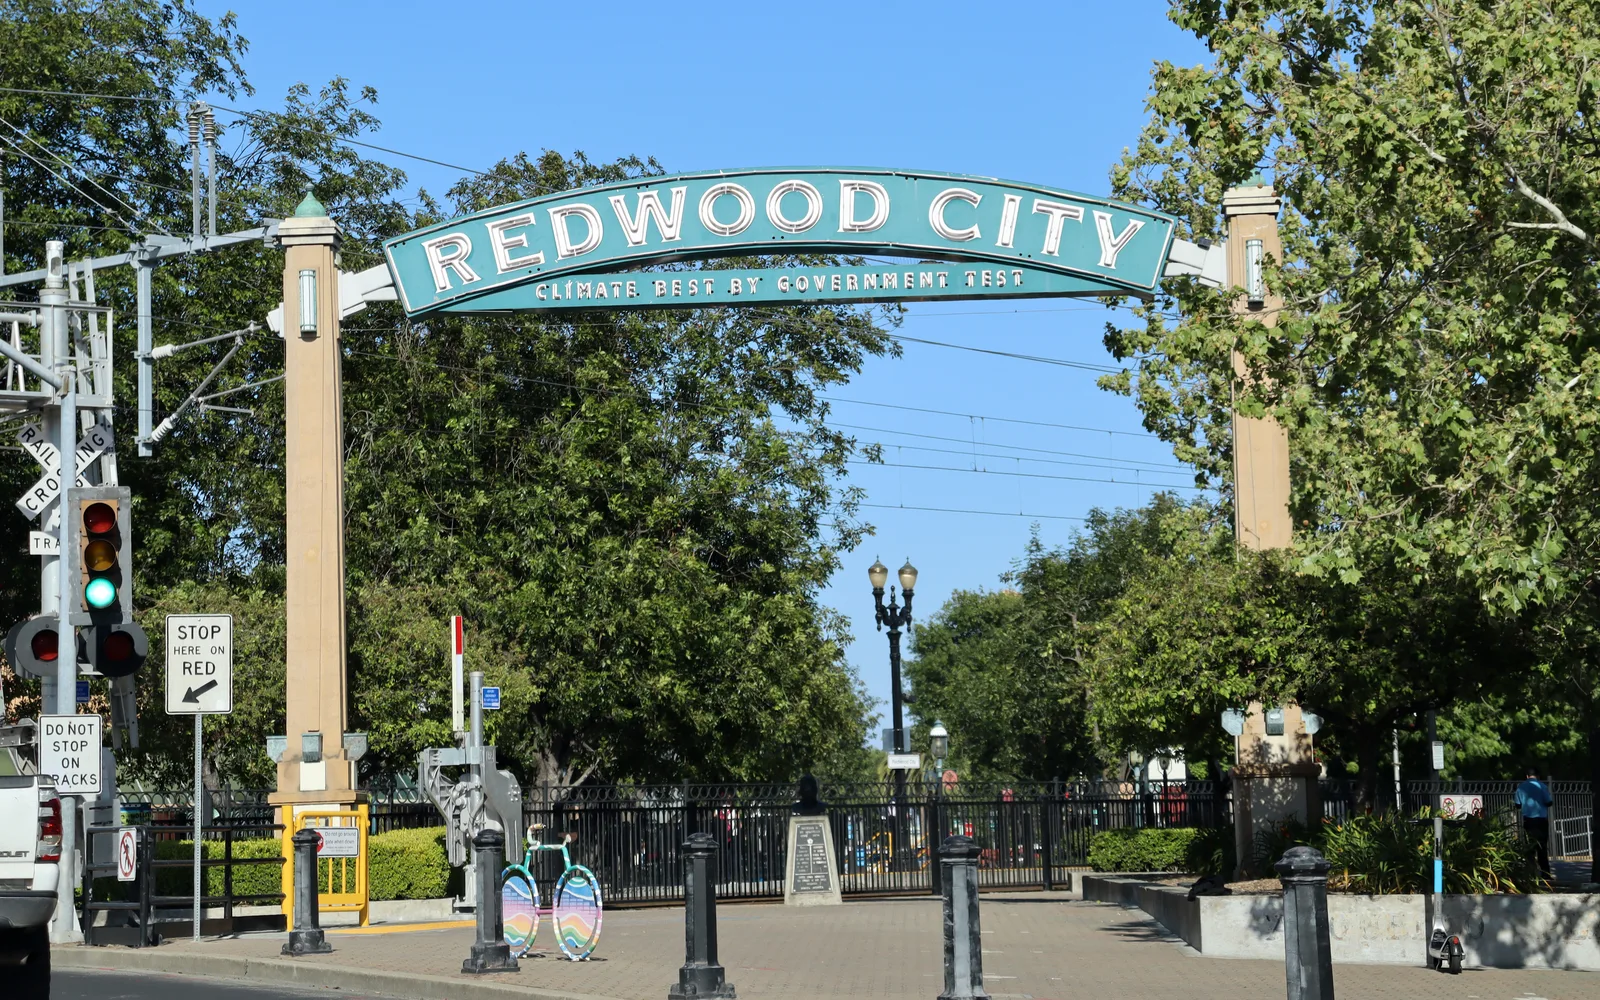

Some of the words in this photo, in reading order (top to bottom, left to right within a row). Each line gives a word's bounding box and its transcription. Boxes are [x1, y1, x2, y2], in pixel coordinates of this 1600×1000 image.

[422, 180, 890, 293] REDWOOD
[929, 188, 1146, 269] CITY
[536, 280, 637, 300] CLIMATE
[655, 278, 715, 296] BEST
[730, 277, 759, 294] BY
[777, 272, 949, 293] GOVERNMENT
[964, 270, 1024, 287] TEST
[22, 427, 55, 466] RAIL
[26, 433, 105, 511] CROING
[34, 538, 60, 548] TRA
[178, 625, 221, 640] STOP
[173, 646, 201, 655] HERE
[210, 646, 225, 655] ON
[183, 661, 216, 675] RED
[46, 724, 64, 735] DO
[68, 724, 95, 735] NOT
[53, 741, 88, 752] STOP
[61, 757, 80, 769] ON
[52, 774, 97, 785] RACKS
